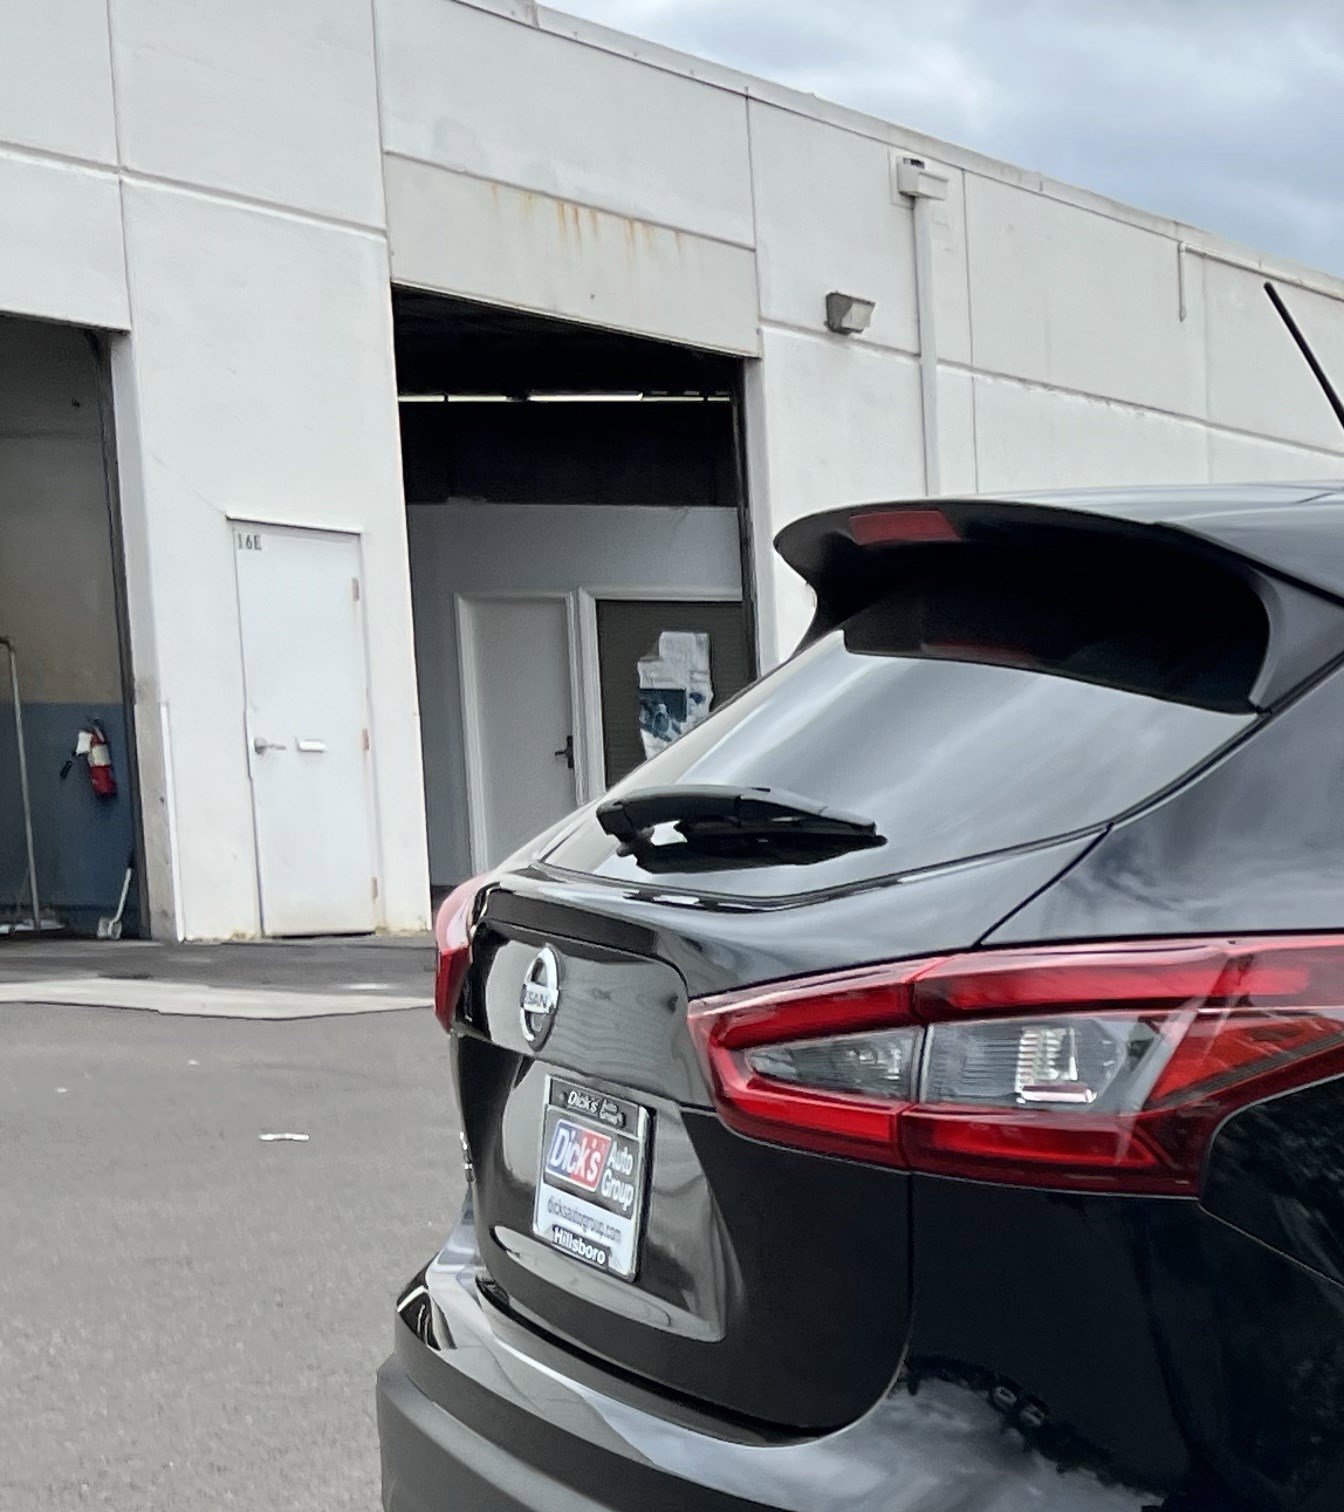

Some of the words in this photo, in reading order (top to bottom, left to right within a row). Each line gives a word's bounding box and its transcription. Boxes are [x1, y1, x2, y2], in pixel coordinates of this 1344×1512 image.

[549, 1128, 605, 1182] Dick's
[607, 1141, 634, 1176] Auto
[602, 1168, 634, 1211] Group
[554, 1227, 606, 1265] Hillsboro
